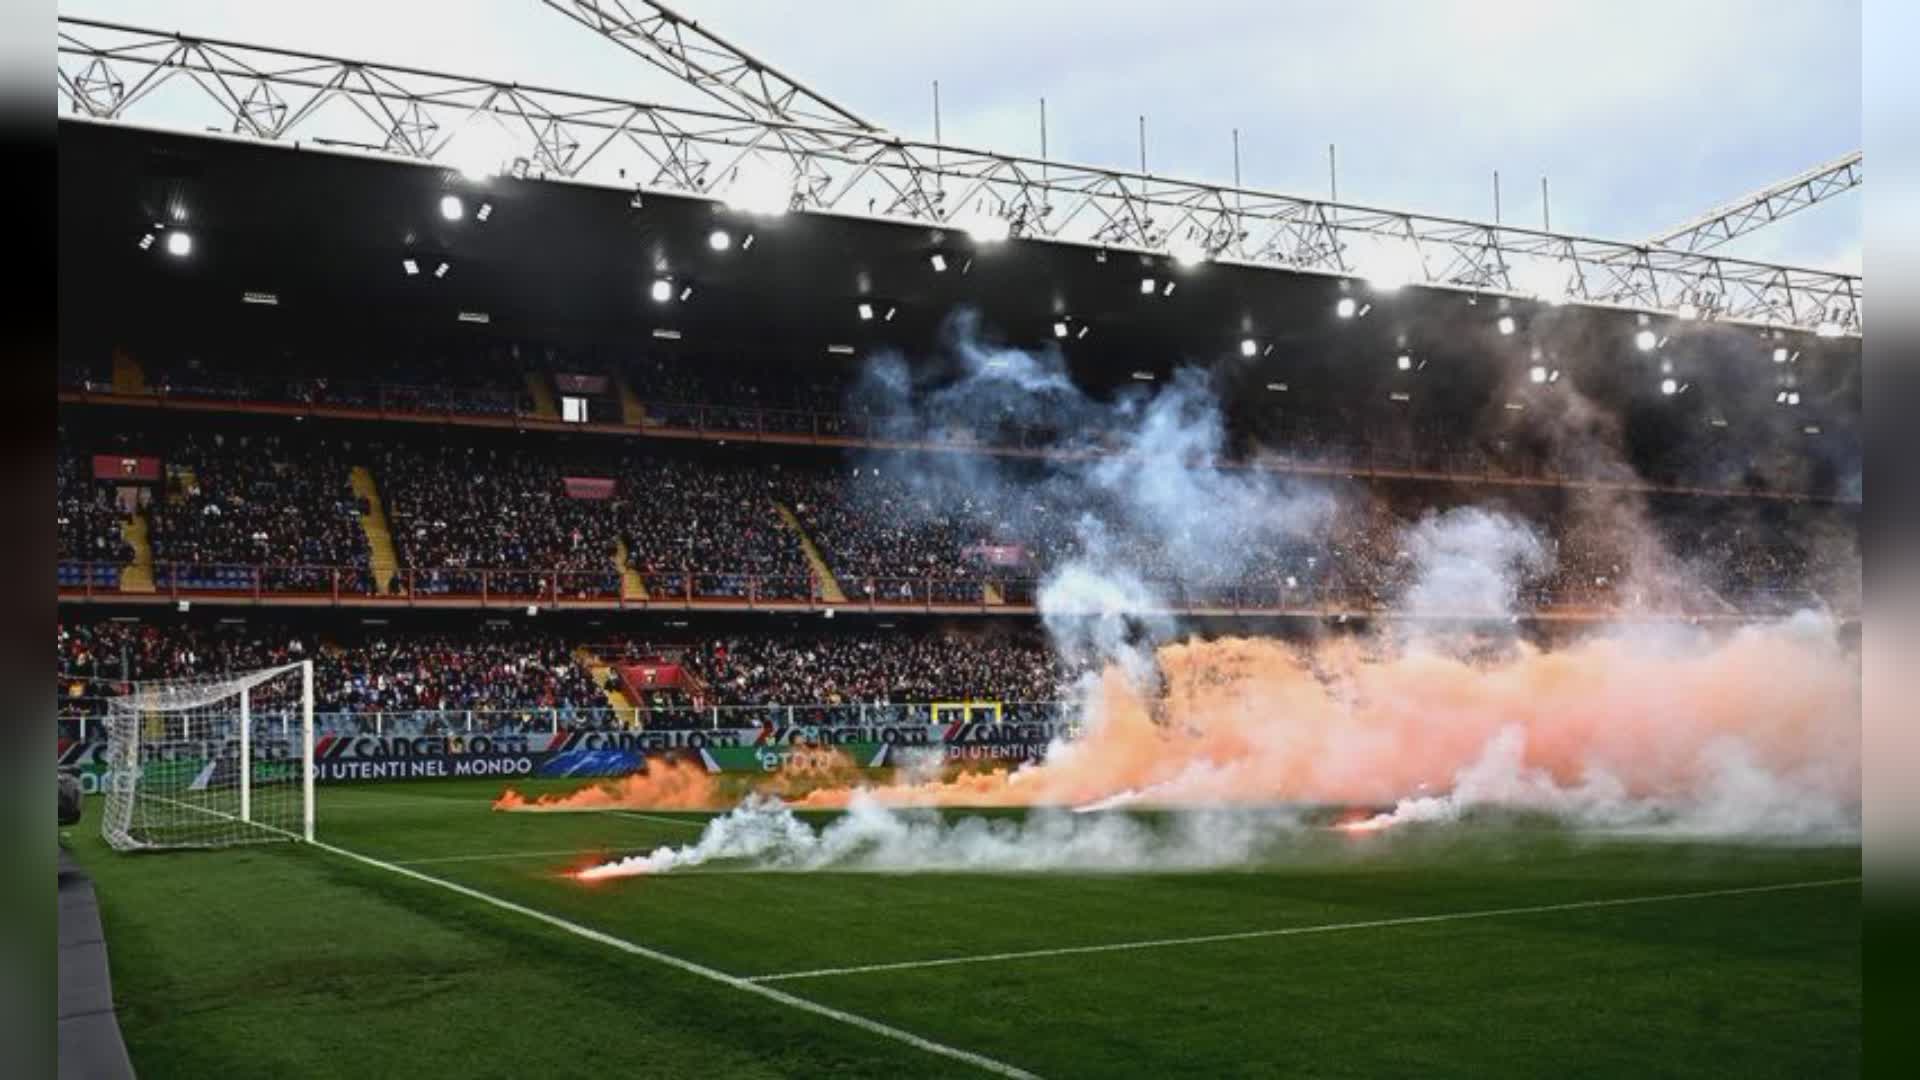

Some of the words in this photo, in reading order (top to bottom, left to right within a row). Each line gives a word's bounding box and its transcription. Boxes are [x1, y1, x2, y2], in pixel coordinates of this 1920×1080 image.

[970, 743, 1025, 759] UTENTI
[332, 761, 406, 780] UTENTI
[411, 759, 448, 777] NEL
[454, 757, 533, 776] MONDO
